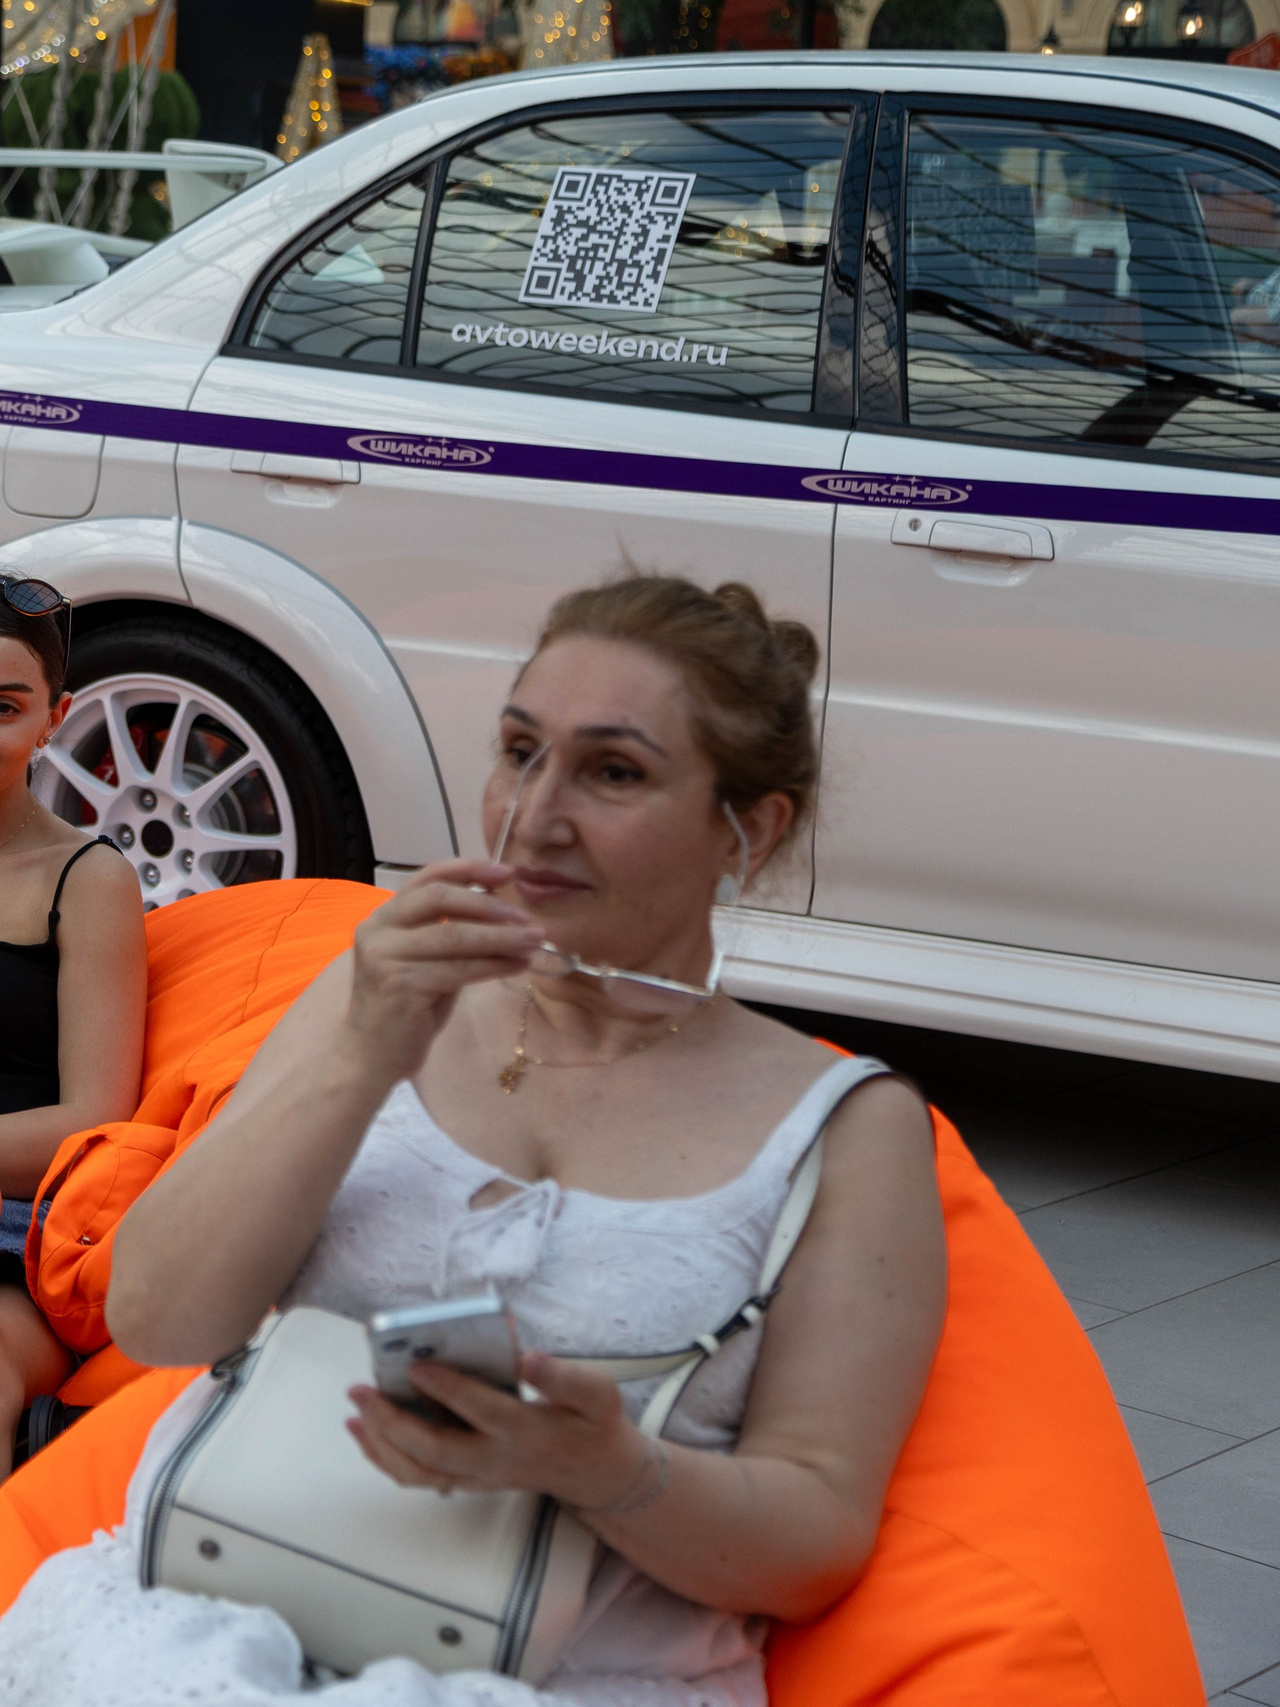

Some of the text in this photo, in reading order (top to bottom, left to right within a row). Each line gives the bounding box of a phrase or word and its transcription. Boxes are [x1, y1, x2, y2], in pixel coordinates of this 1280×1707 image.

[451, 322, 729, 366] avtoweekend.ru
[370, 440, 476, 462] ШИКАНА
[405, 457, 442, 466] КАРТИНГ
[827, 479, 951, 500] ШИКАНА
[868, 496, 911, 505] КАРТИНГ
